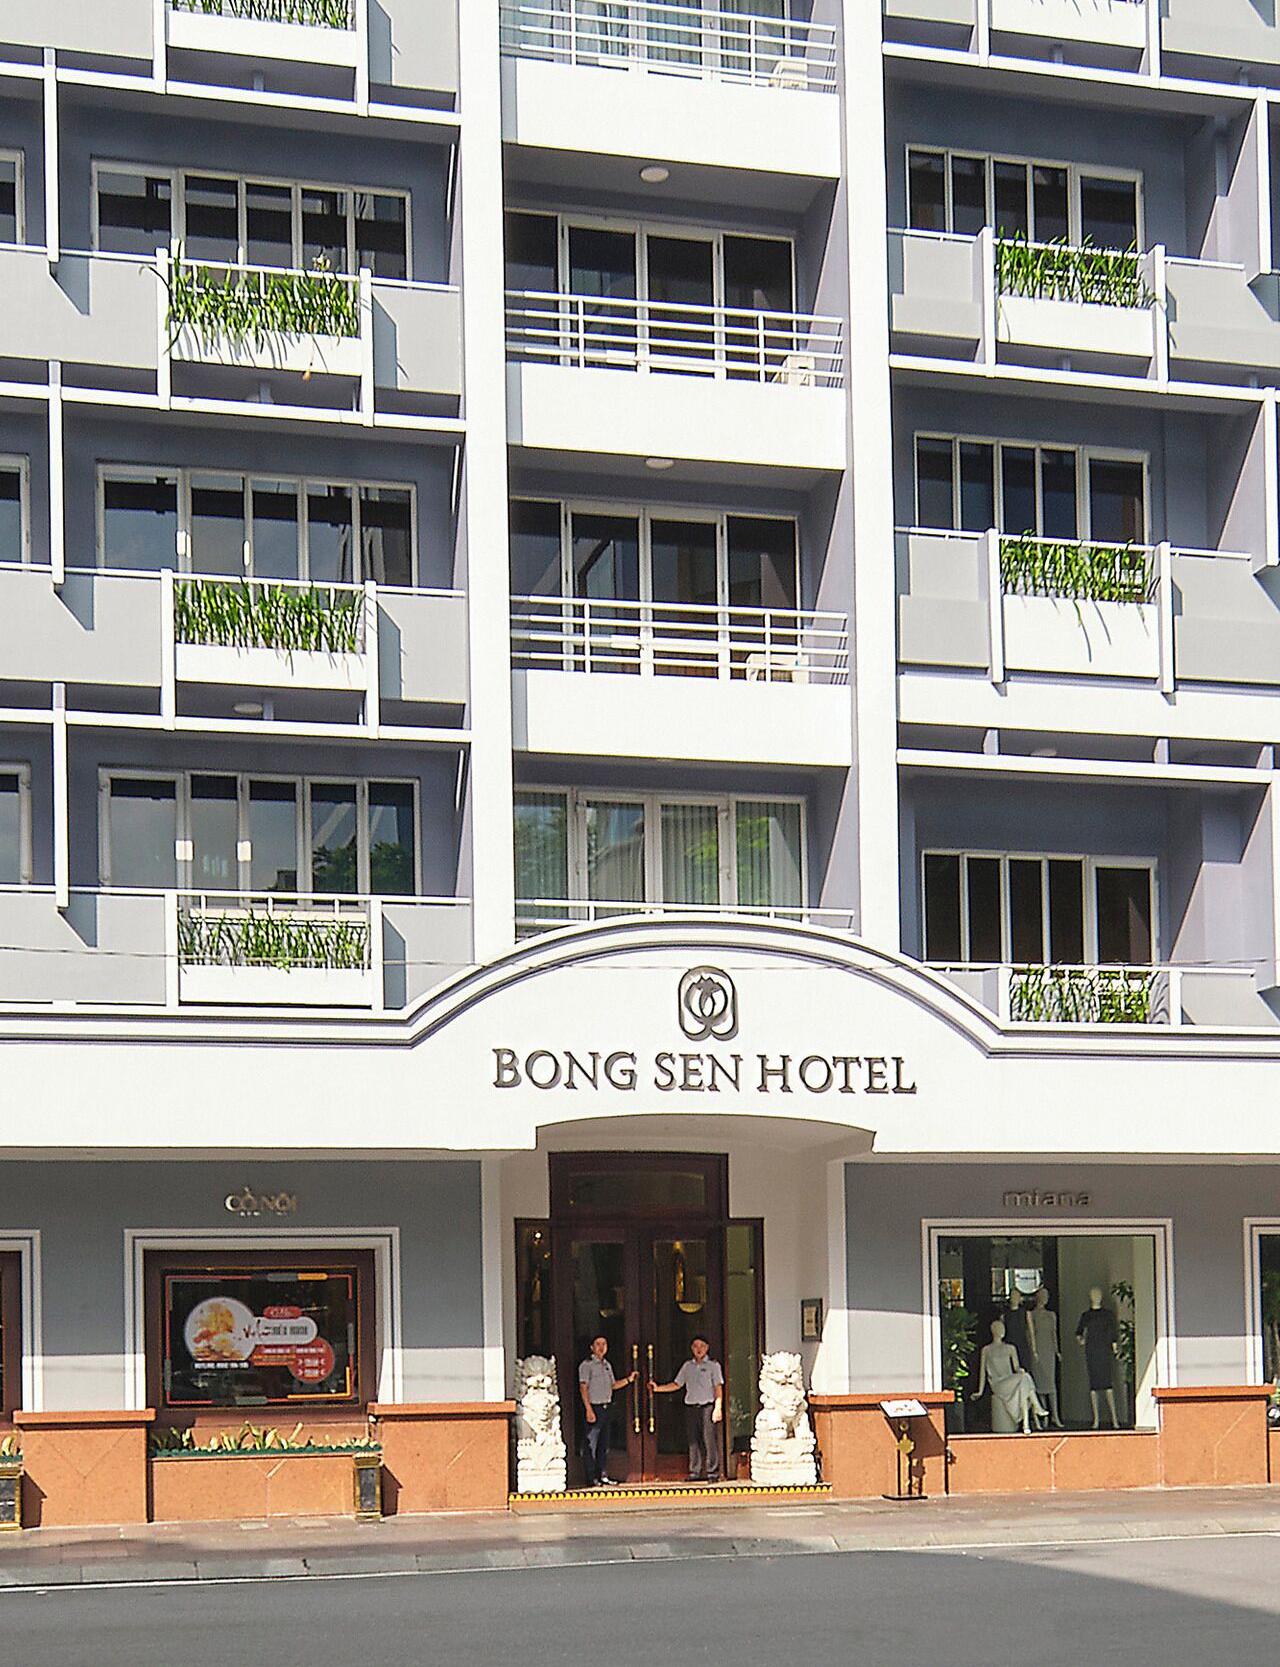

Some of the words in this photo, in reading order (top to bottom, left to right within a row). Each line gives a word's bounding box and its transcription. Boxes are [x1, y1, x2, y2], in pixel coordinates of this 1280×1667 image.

[492, 1047, 638, 1091] BONG
[654, 1051, 743, 1093] SEN
[756, 1053, 918, 1094] HOTEL
[1002, 1189, 1091, 1207] miana
